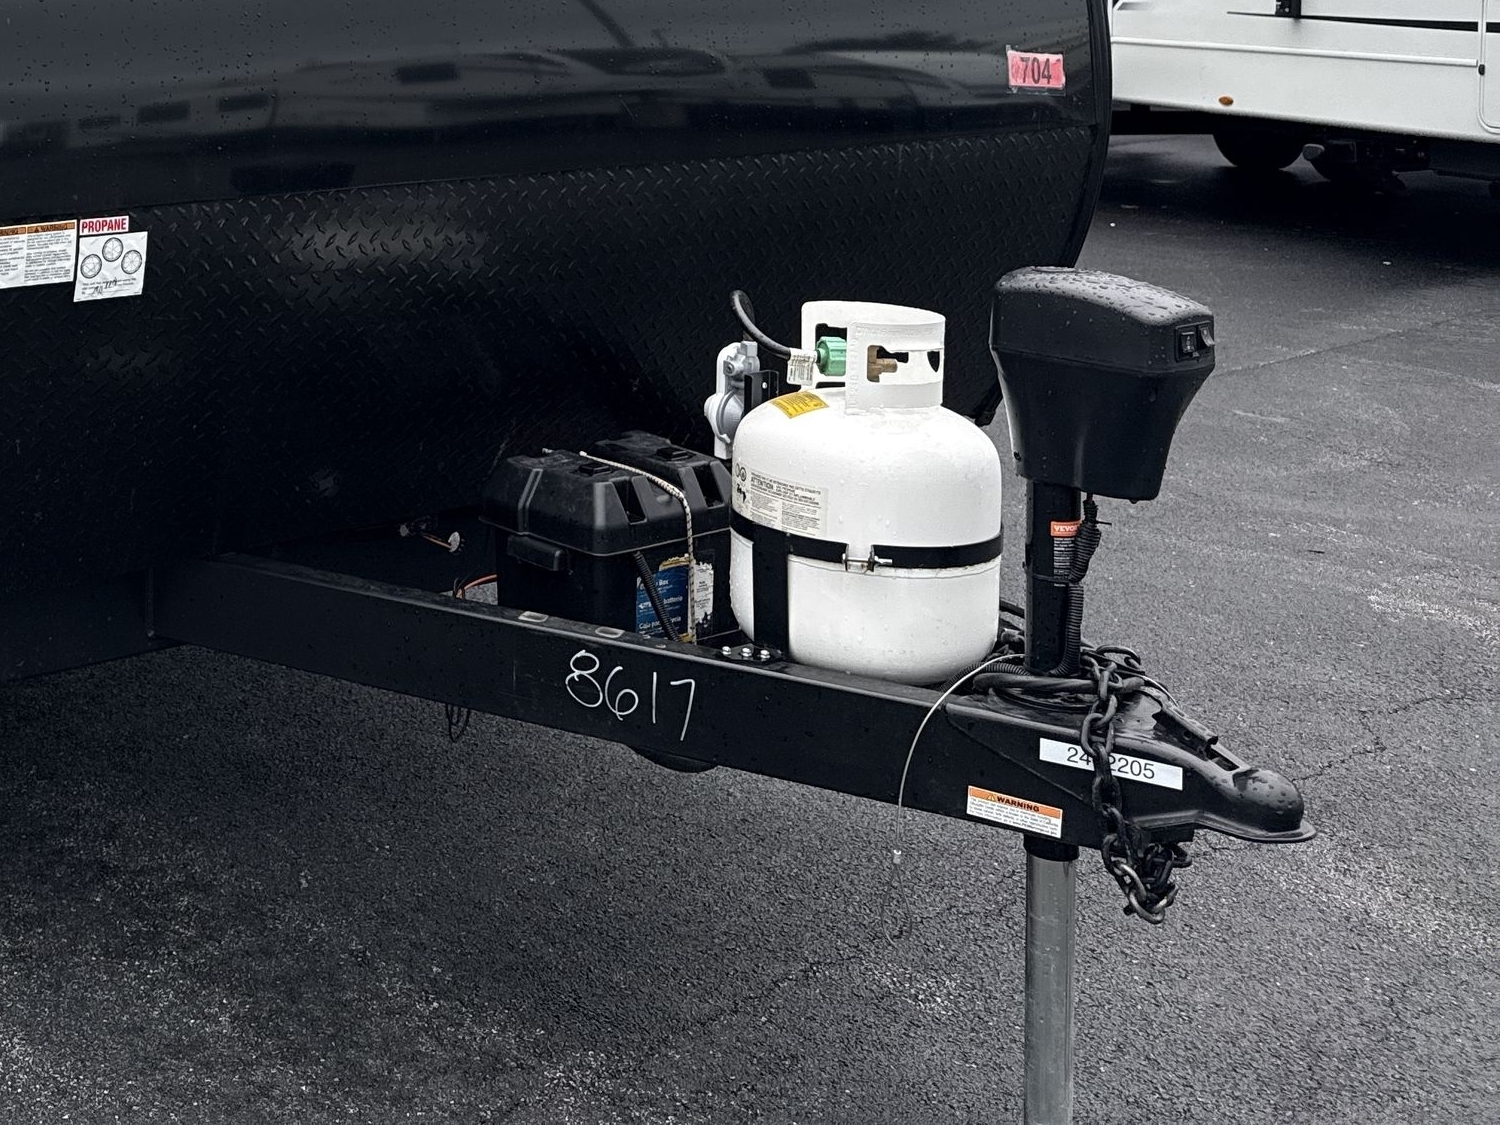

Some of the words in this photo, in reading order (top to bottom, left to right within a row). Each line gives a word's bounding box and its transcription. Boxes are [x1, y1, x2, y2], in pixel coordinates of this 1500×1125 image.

[1020, 56, 1052, 85] 704
[80, 217, 128, 234] PROPANE
[1053, 524, 1078, 532] VEVO
[565, 649, 696, 742] 8617
[1066, 746, 1155, 780] 242205
[996, 795, 1041, 813] WARNING
